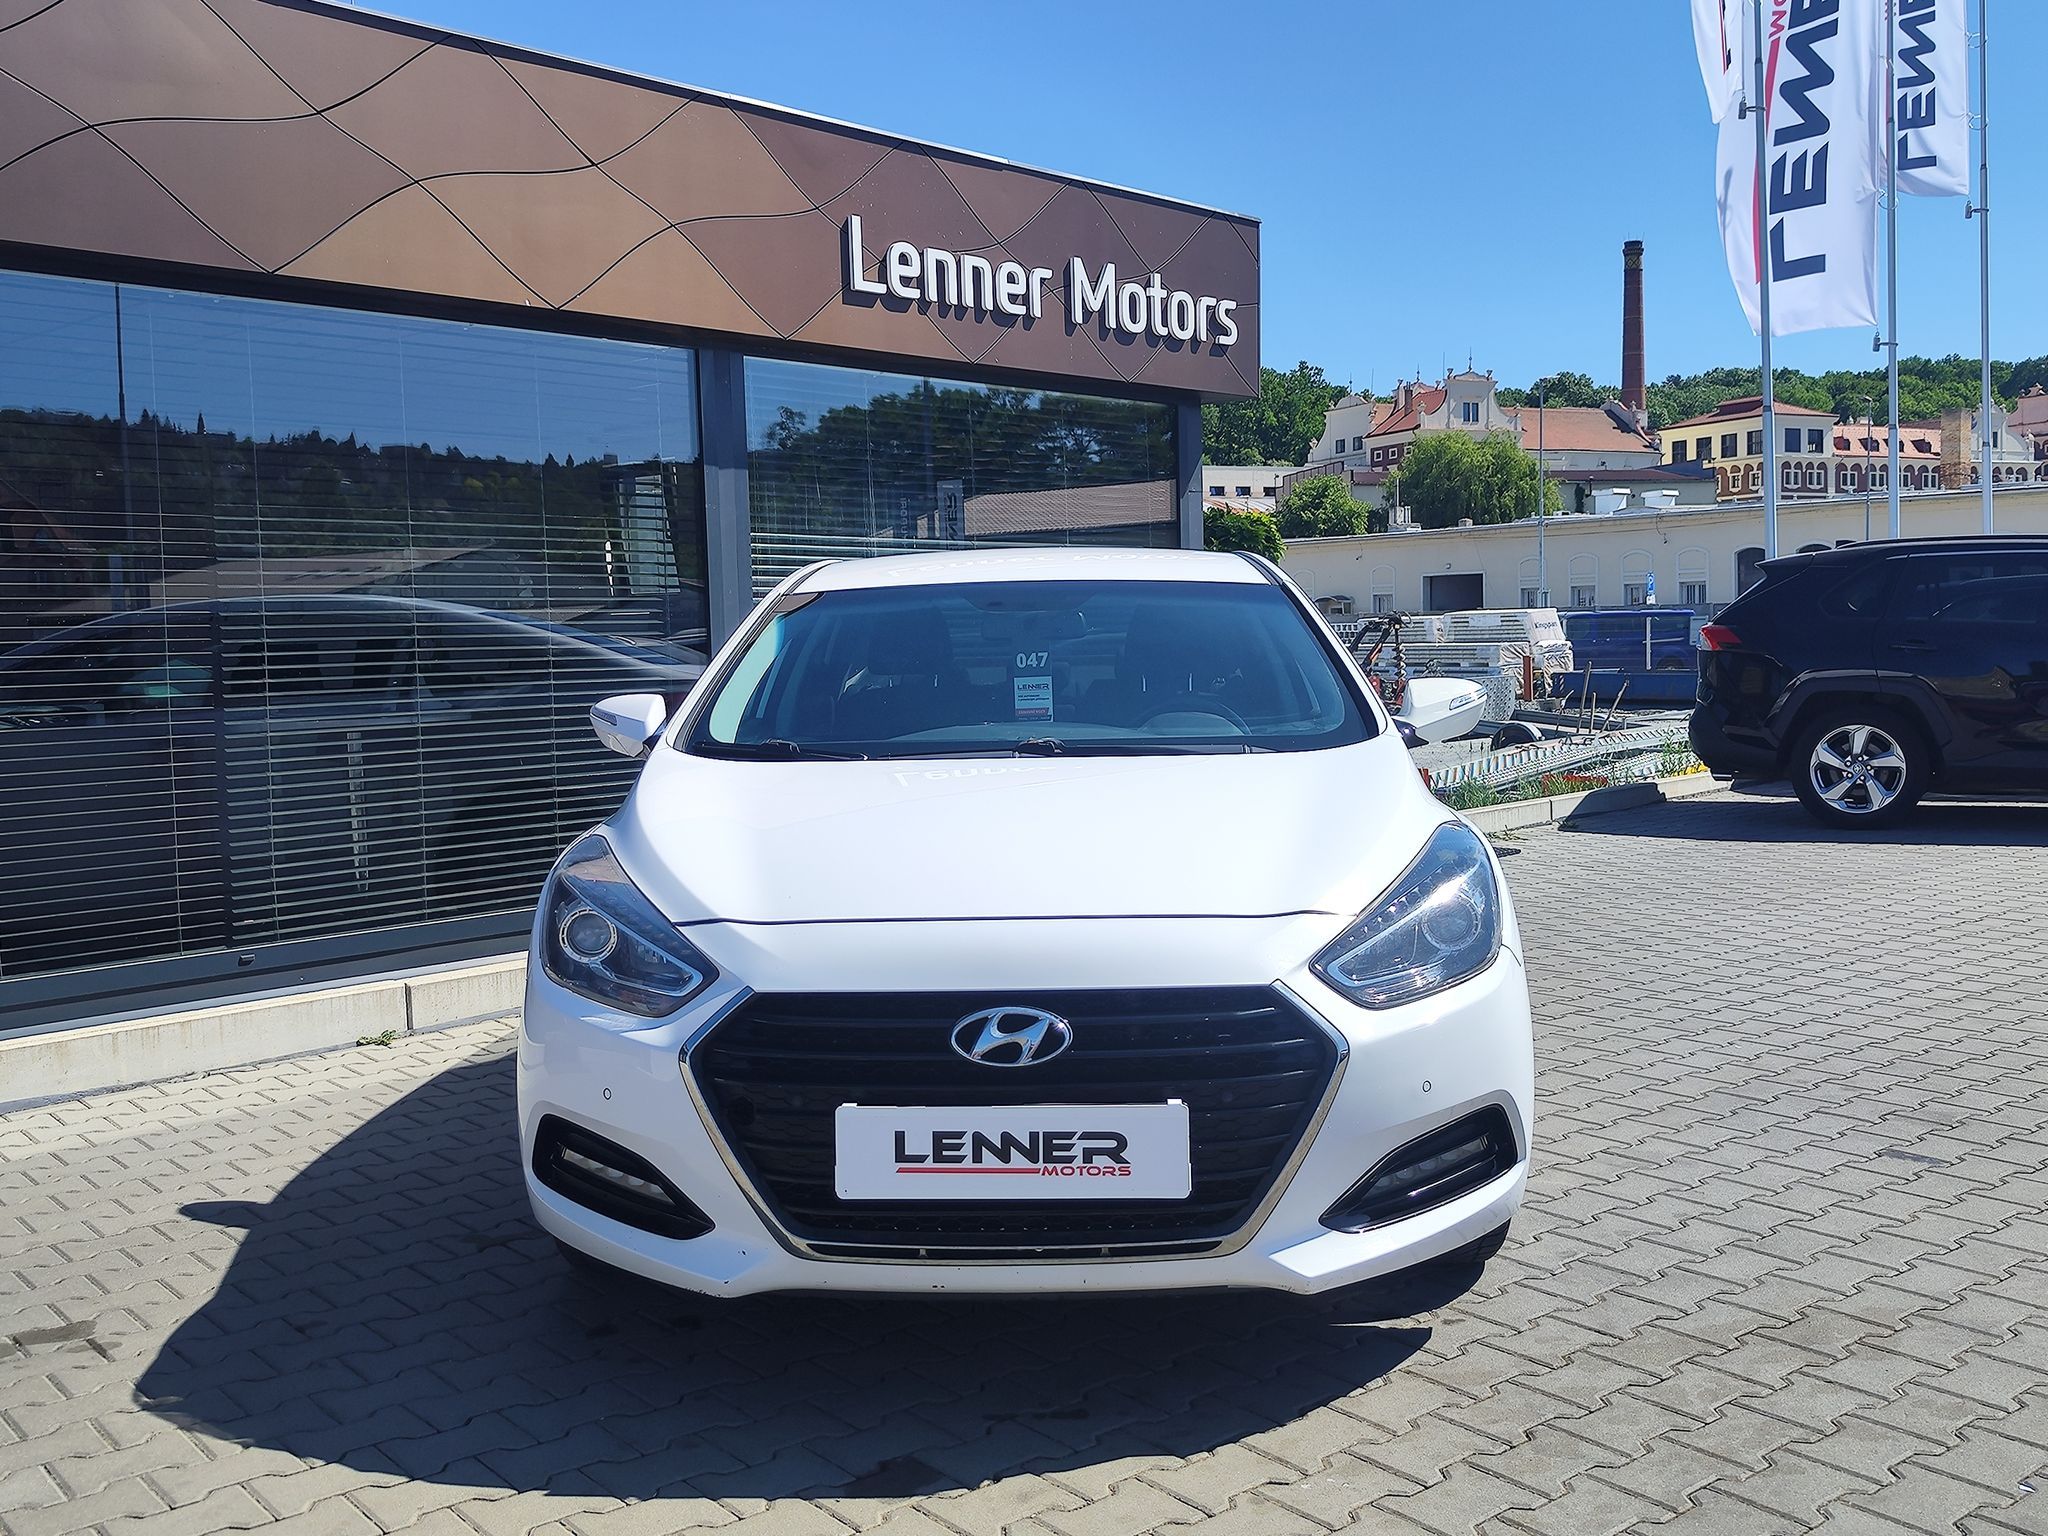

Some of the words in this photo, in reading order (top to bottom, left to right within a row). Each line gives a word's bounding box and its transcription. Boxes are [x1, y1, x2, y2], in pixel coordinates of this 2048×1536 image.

[846, 213, 1053, 320] Lenner
[1069, 255, 1238, 346] Motors
[1016, 651, 1049, 668] 047
[1017, 682, 1050, 691] LENNER
[894, 1130, 1131, 1165] LENNER
[1041, 1165, 1132, 1177] MOTORS
